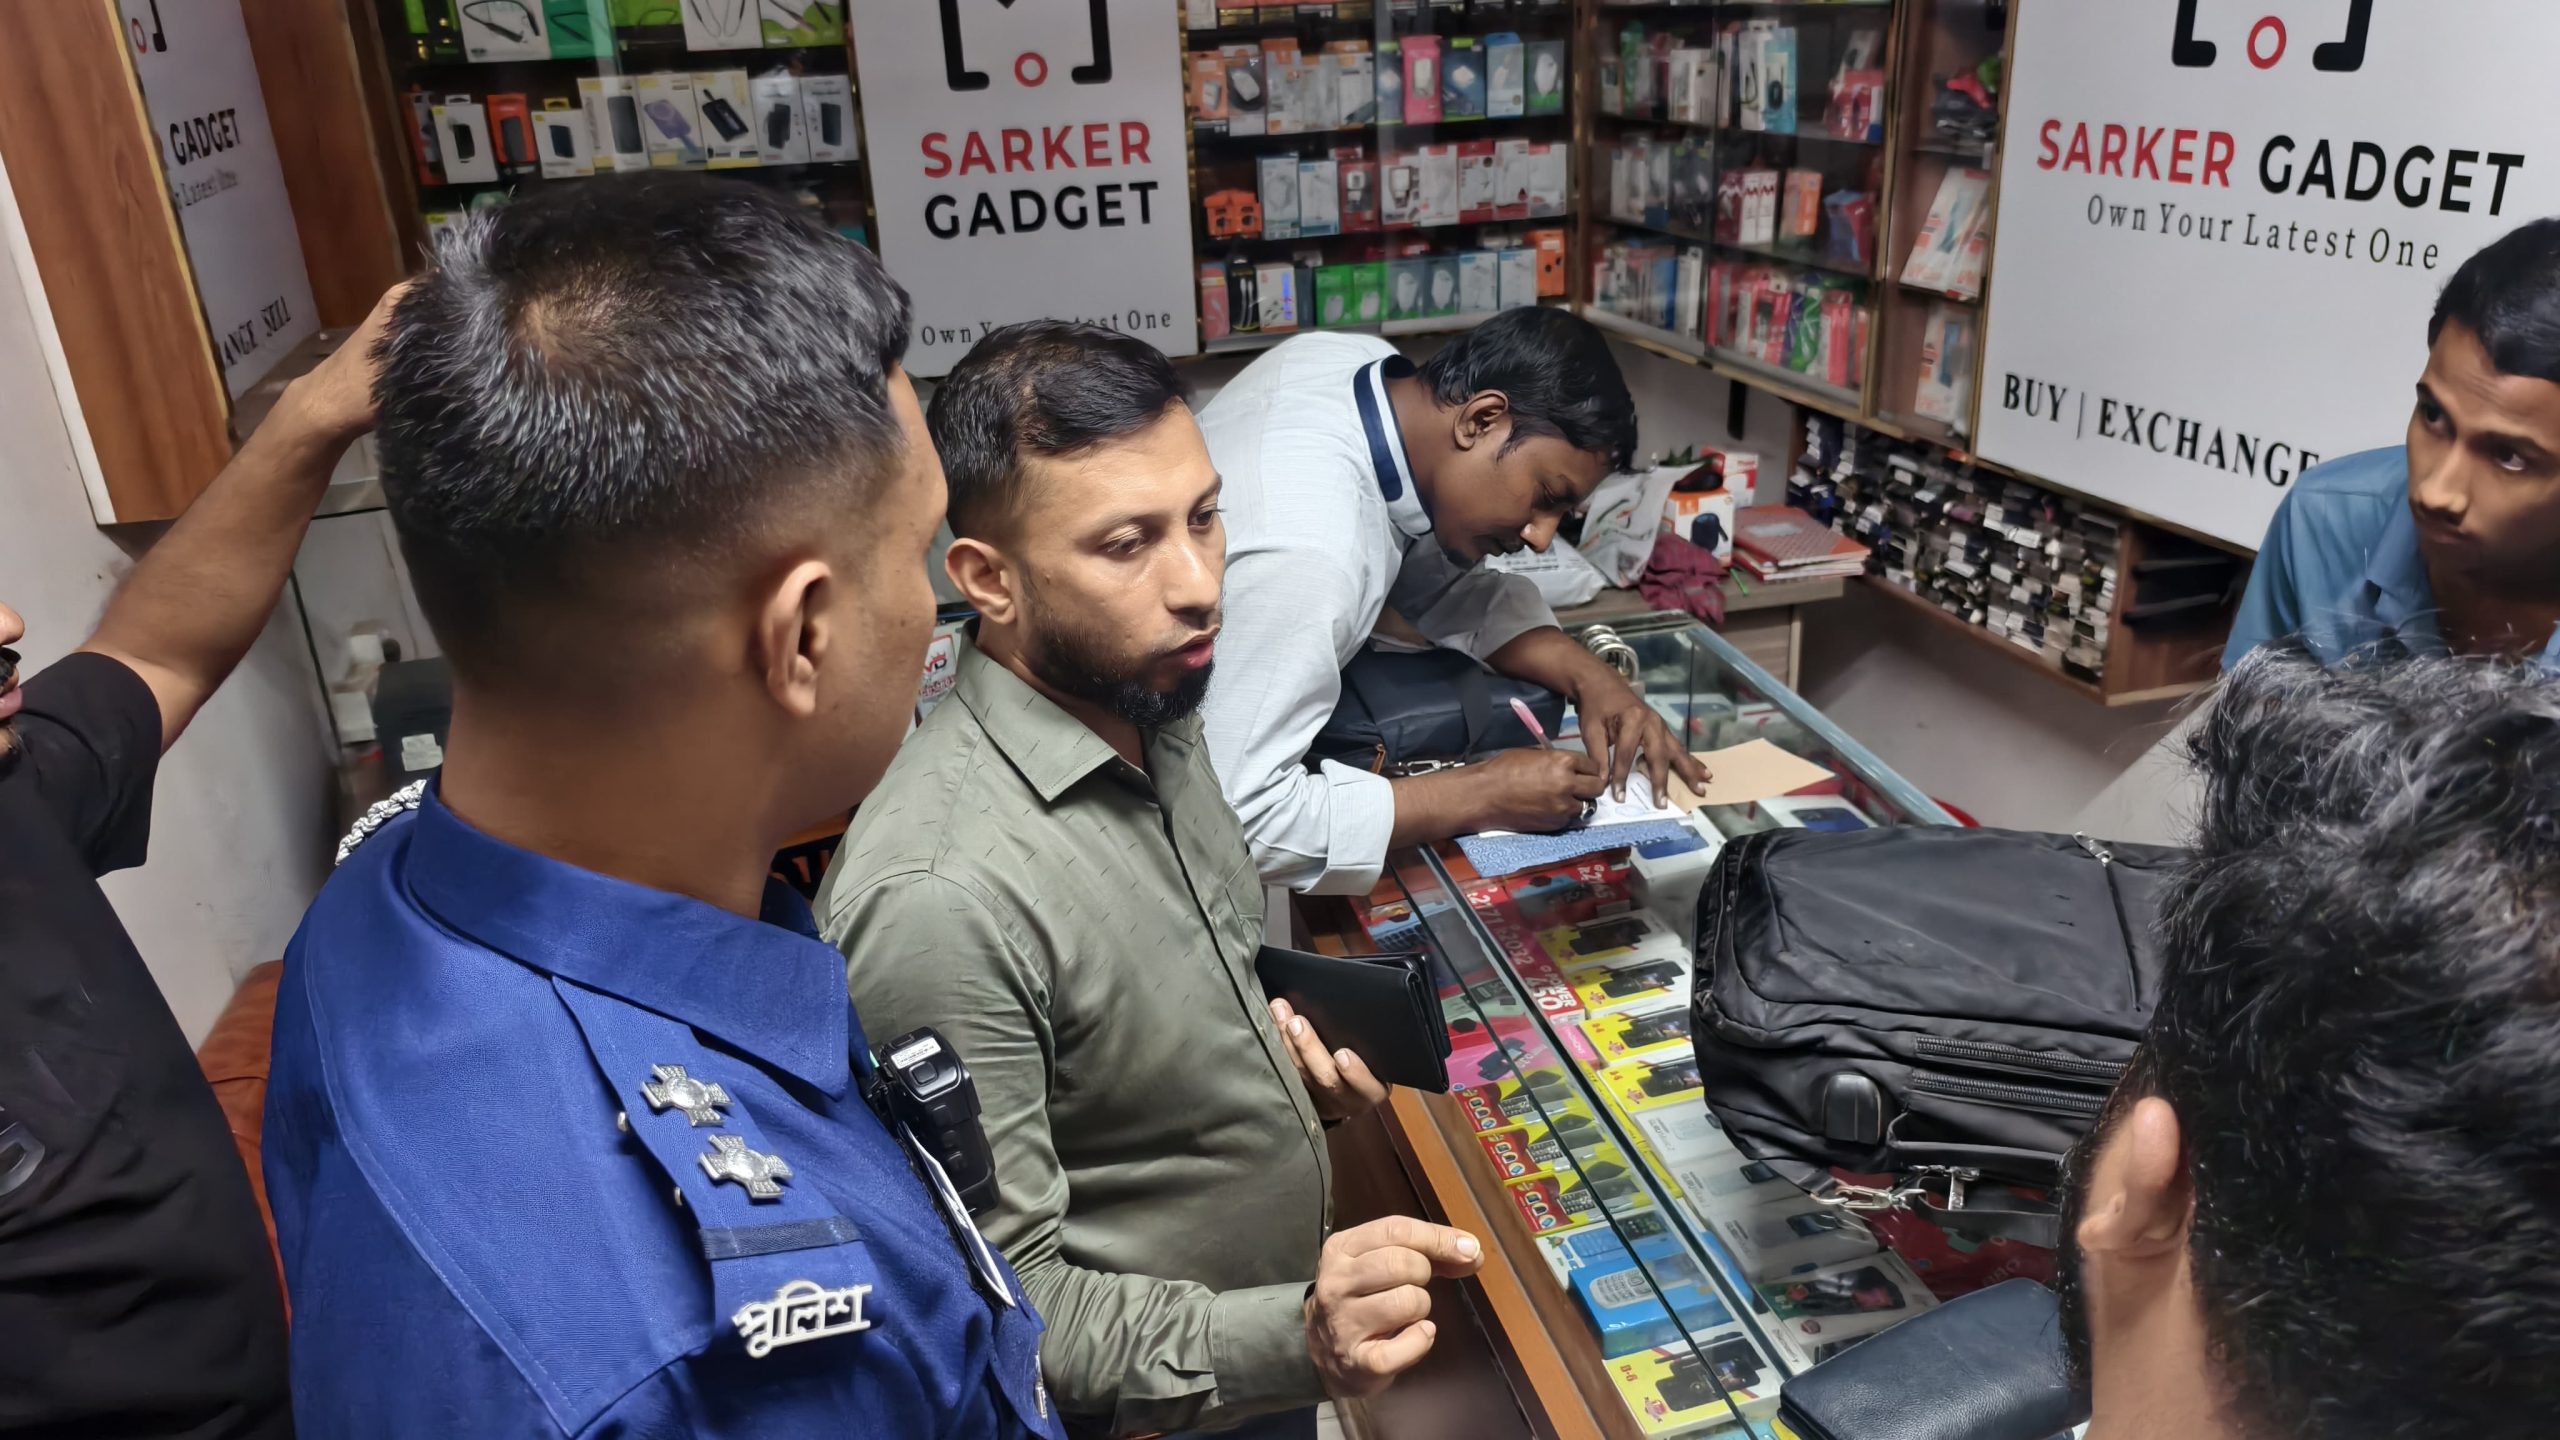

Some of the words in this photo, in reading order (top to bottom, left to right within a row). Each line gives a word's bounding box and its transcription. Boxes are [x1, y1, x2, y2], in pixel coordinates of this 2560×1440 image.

[170, 108, 241, 166] GADGET
[921, 121, 1151, 178] SARKER
[2036, 118, 2236, 188] SARKER
[2258, 134, 2526, 216] GADGET
[925, 181, 1158, 240] GADGET
[2087, 194, 2146, 231] Own
[2158, 203, 2233, 243] Your
[2243, 213, 2356, 261] Latest
[2368, 228, 2440, 270] One
[921, 325, 972, 346] Own
[1126, 309, 1172, 331] One
[2002, 373, 2067, 423] BUY
[732, 1280, 873, 1358] পুলিশ
